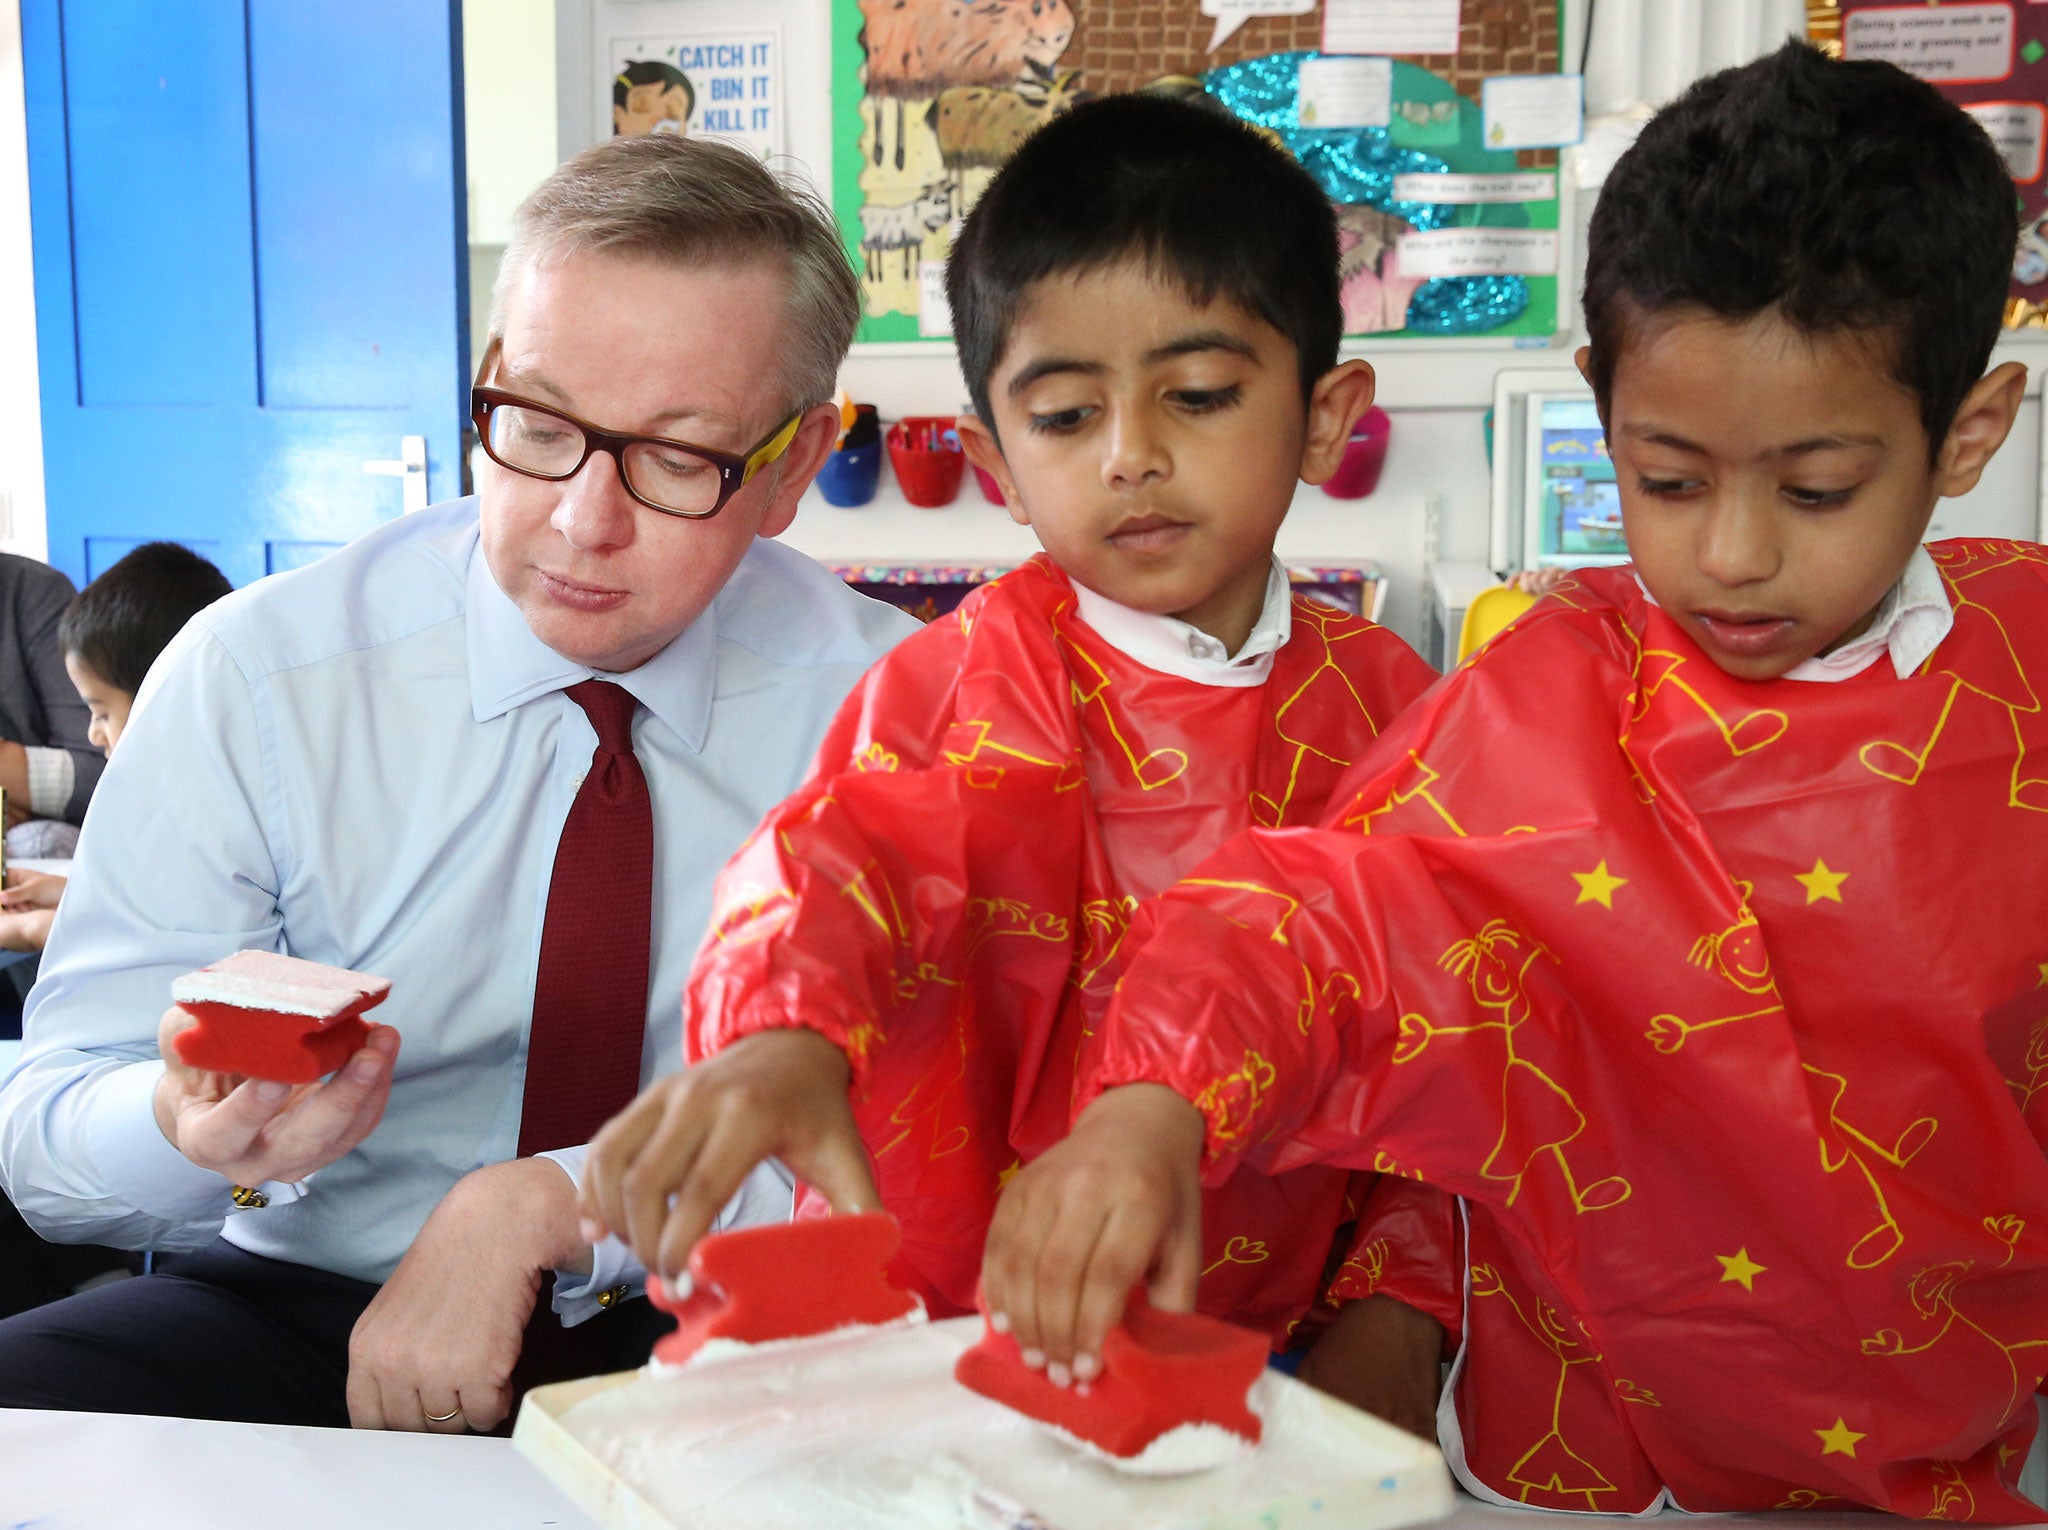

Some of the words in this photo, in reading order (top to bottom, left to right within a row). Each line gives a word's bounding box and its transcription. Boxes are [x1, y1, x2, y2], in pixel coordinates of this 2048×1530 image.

[1851, 17, 1894, 31] During
[1900, 18, 1944, 28] science
[1951, 15, 1982, 26] week
[1989, 15, 2005, 24] we
[1853, 39, 1896, 50] looked
[1902, 38, 1914, 48] at
[1921, 37, 1971, 50] growing
[1978, 34, 2002, 45] and
[679, 46, 744, 69] CATCH
[752, 44, 769, 66] IT
[711, 79, 743, 100] BIN
[752, 77, 769, 98] IT
[704, 109, 745, 131] KILL
[752, 108, 769, 130] IT
[1481, 235, 1538, 247] characters
